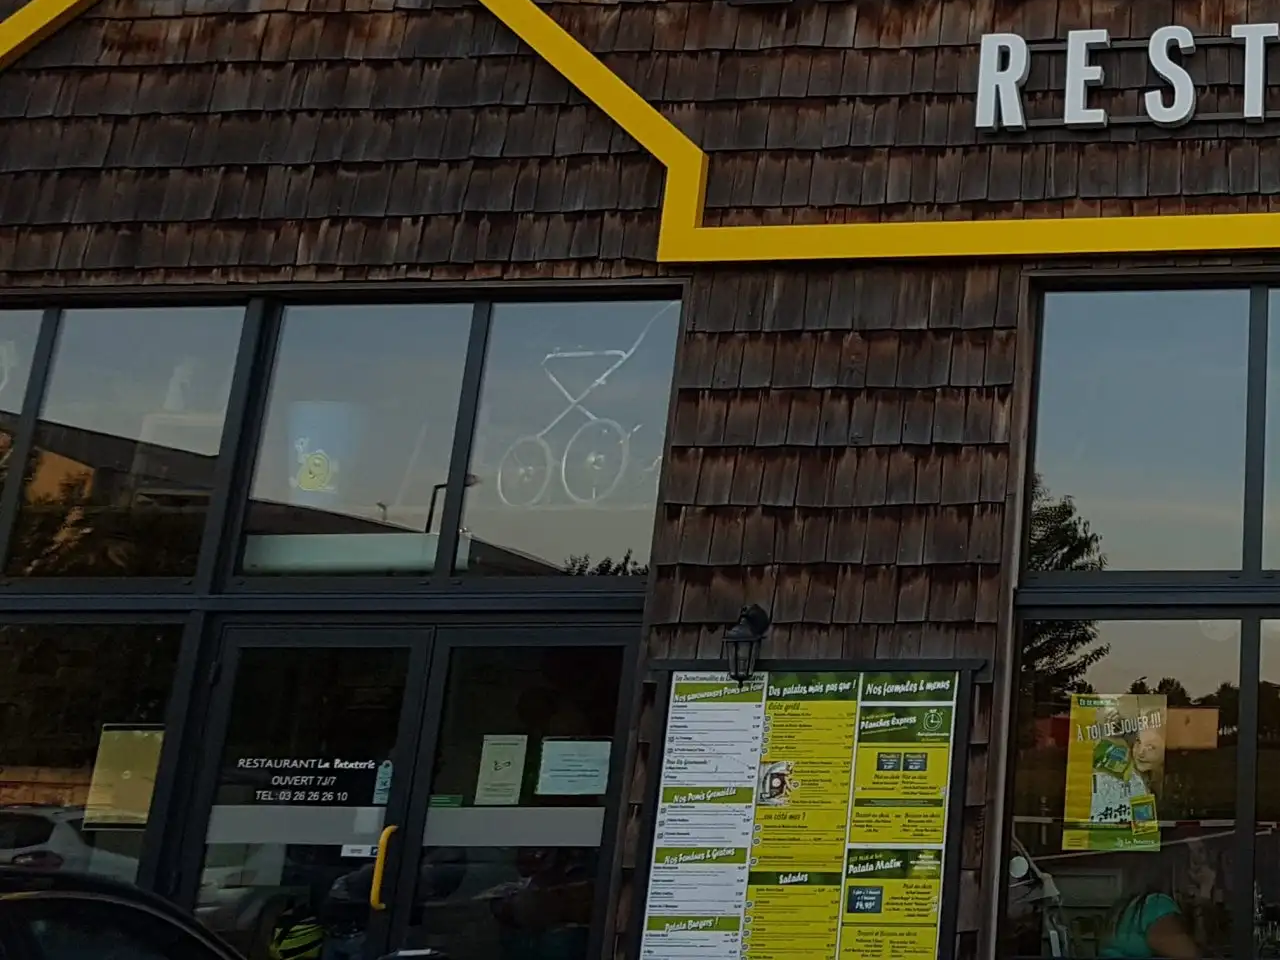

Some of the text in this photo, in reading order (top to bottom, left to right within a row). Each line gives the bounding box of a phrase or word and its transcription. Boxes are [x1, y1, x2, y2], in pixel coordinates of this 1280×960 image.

[865, 683, 882, 696] Nos
[1086, 723, 1102, 740] TOI
[1104, 721, 1117, 737] DE
[1117, 715, 1149, 735] JOUER
[1150, 711, 1162, 728] !!!
[237, 758, 376, 770] RESTAURANT La Pataterie
[271, 775, 337, 787] OUVERT 7J/7
[307, 791, 320, 801] 26
[321, 791, 335, 802] 26
[336, 791, 349, 801] 10
[673, 794, 687, 804] Nos
[664, 856, 678, 865] Nos
[779, 872, 808, 884] Salades
